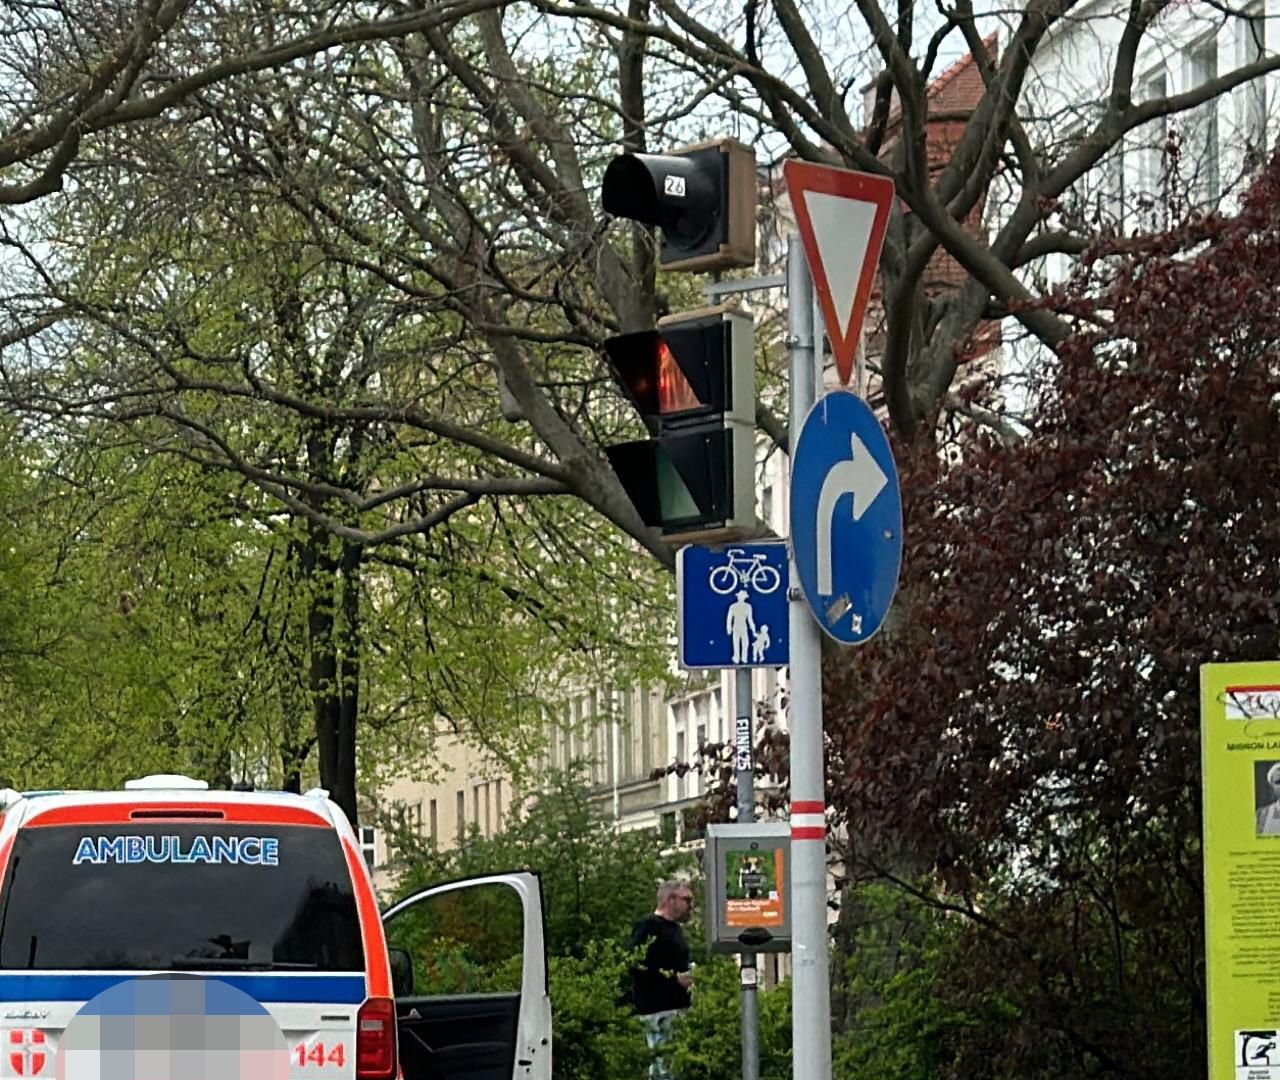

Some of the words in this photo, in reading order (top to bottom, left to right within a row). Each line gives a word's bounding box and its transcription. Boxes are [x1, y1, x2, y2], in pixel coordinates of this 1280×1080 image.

[666, 178, 684, 194] 26
[72, 836, 279, 866] AMBULANCE
[295, 1041, 345, 1067] 144
